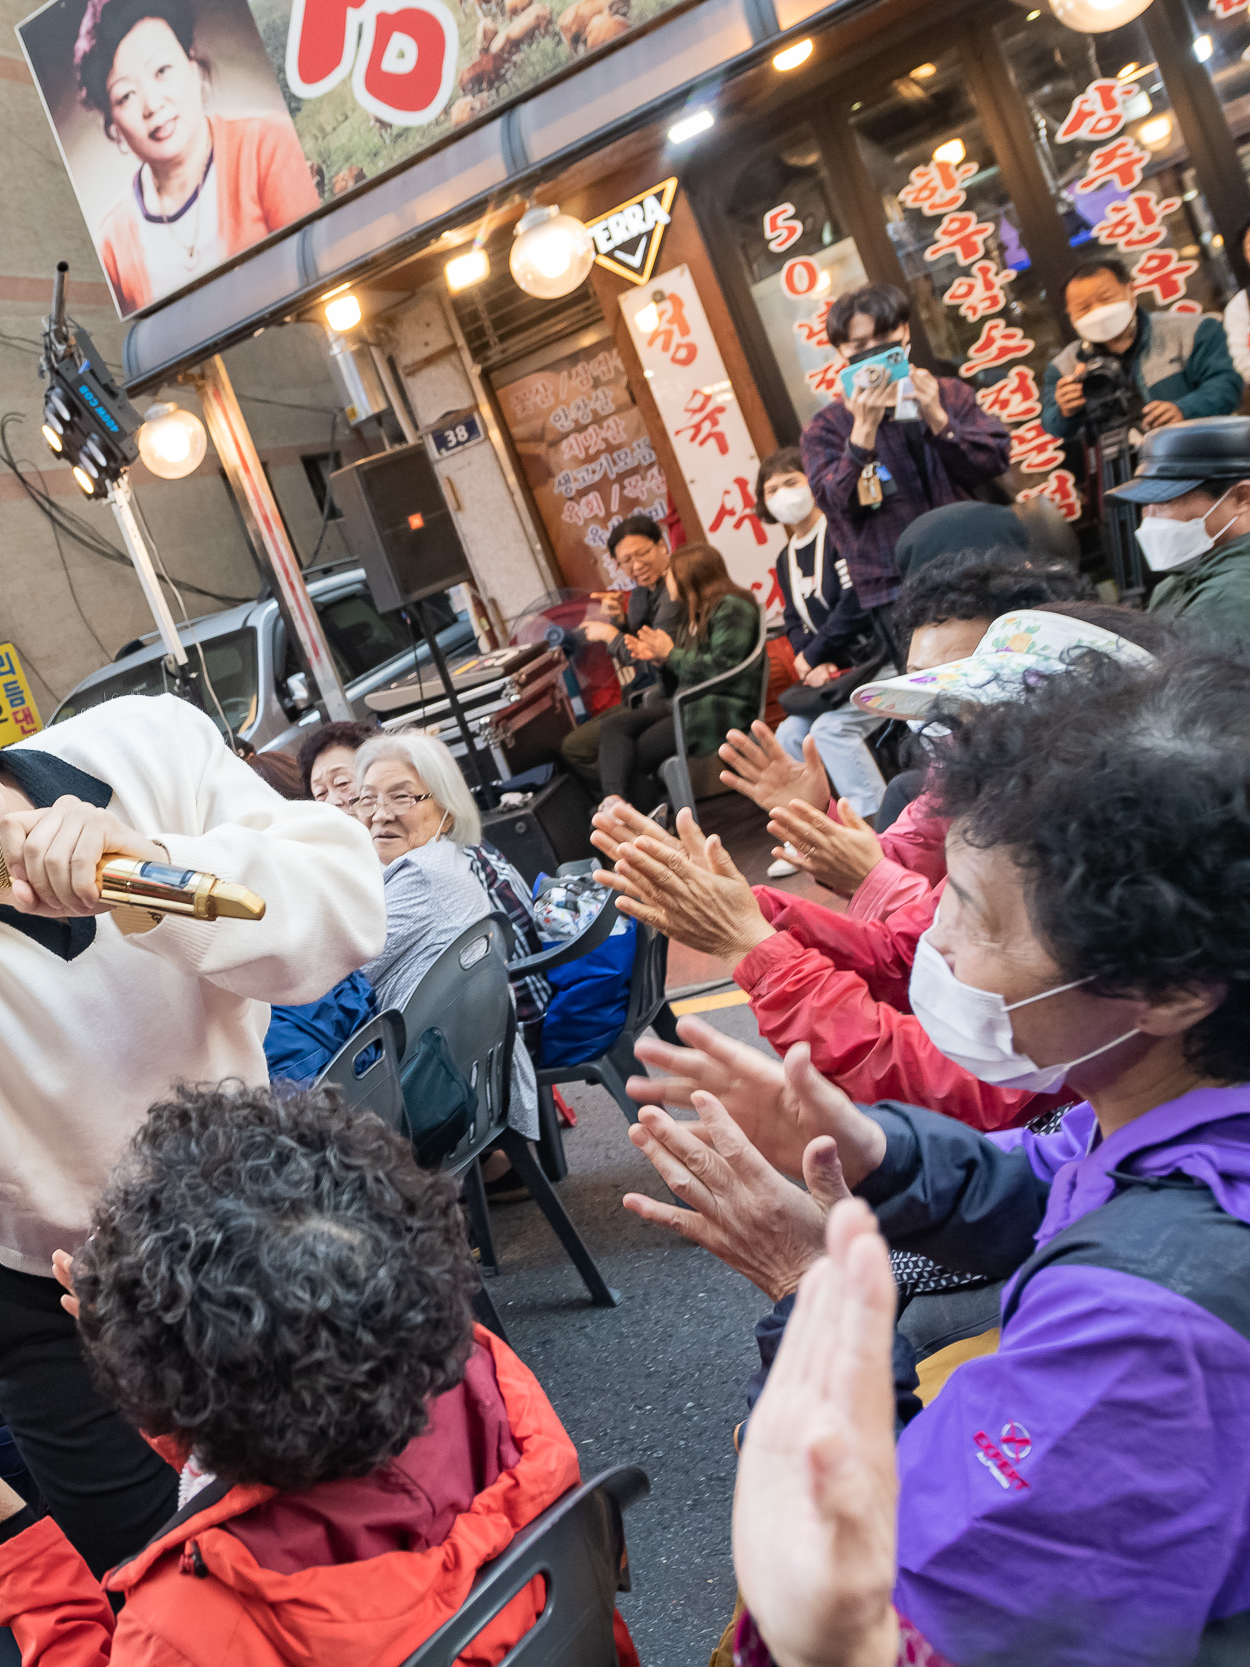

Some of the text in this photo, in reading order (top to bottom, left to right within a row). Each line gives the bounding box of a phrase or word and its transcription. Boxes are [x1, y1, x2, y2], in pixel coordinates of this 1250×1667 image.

[1055, 78, 1202, 314] 상주한우
[588, 194, 672, 255] TERRA
[444, 424, 469, 447] 38
[549, 385, 617, 432] 안창살
